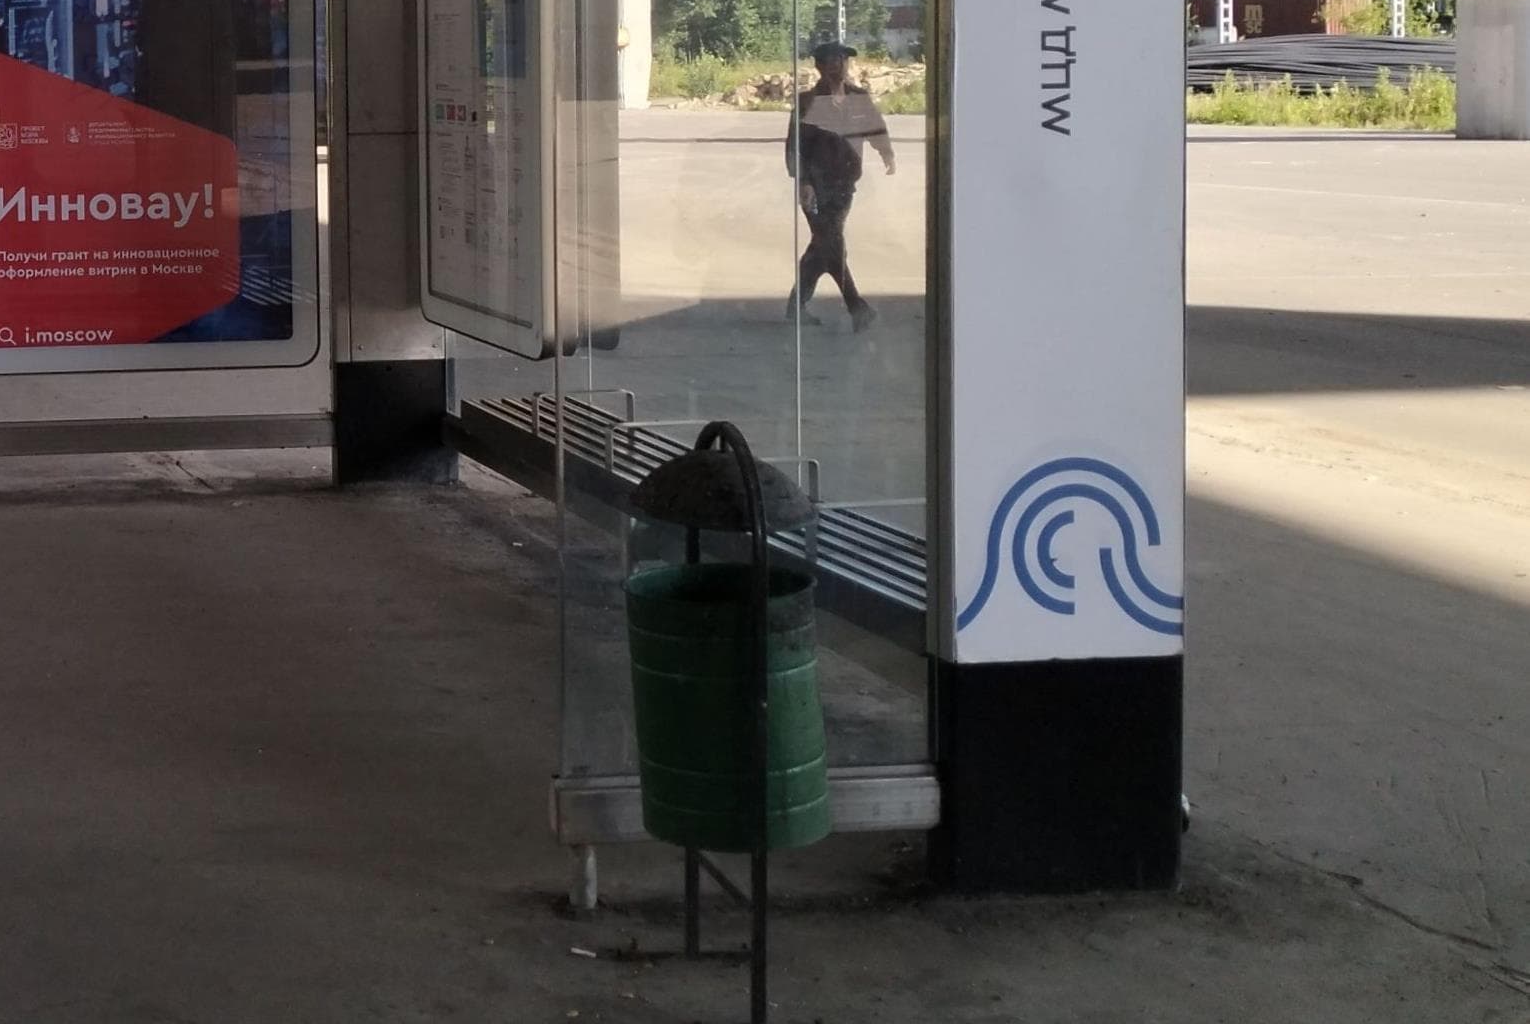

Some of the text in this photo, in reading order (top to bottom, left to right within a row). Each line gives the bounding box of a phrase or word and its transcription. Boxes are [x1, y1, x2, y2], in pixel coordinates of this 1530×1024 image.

[1041, 26, 1077, 136] МЦД
[51, 250, 89, 263] грант
[93, 250, 109, 260] на
[113, 247, 221, 262] инновационное
[88, 266, 136, 278] витрин
[140, 267, 148, 275] в
[152, 263, 203, 275] Москве
[24, 327, 113, 344] i.moscow
